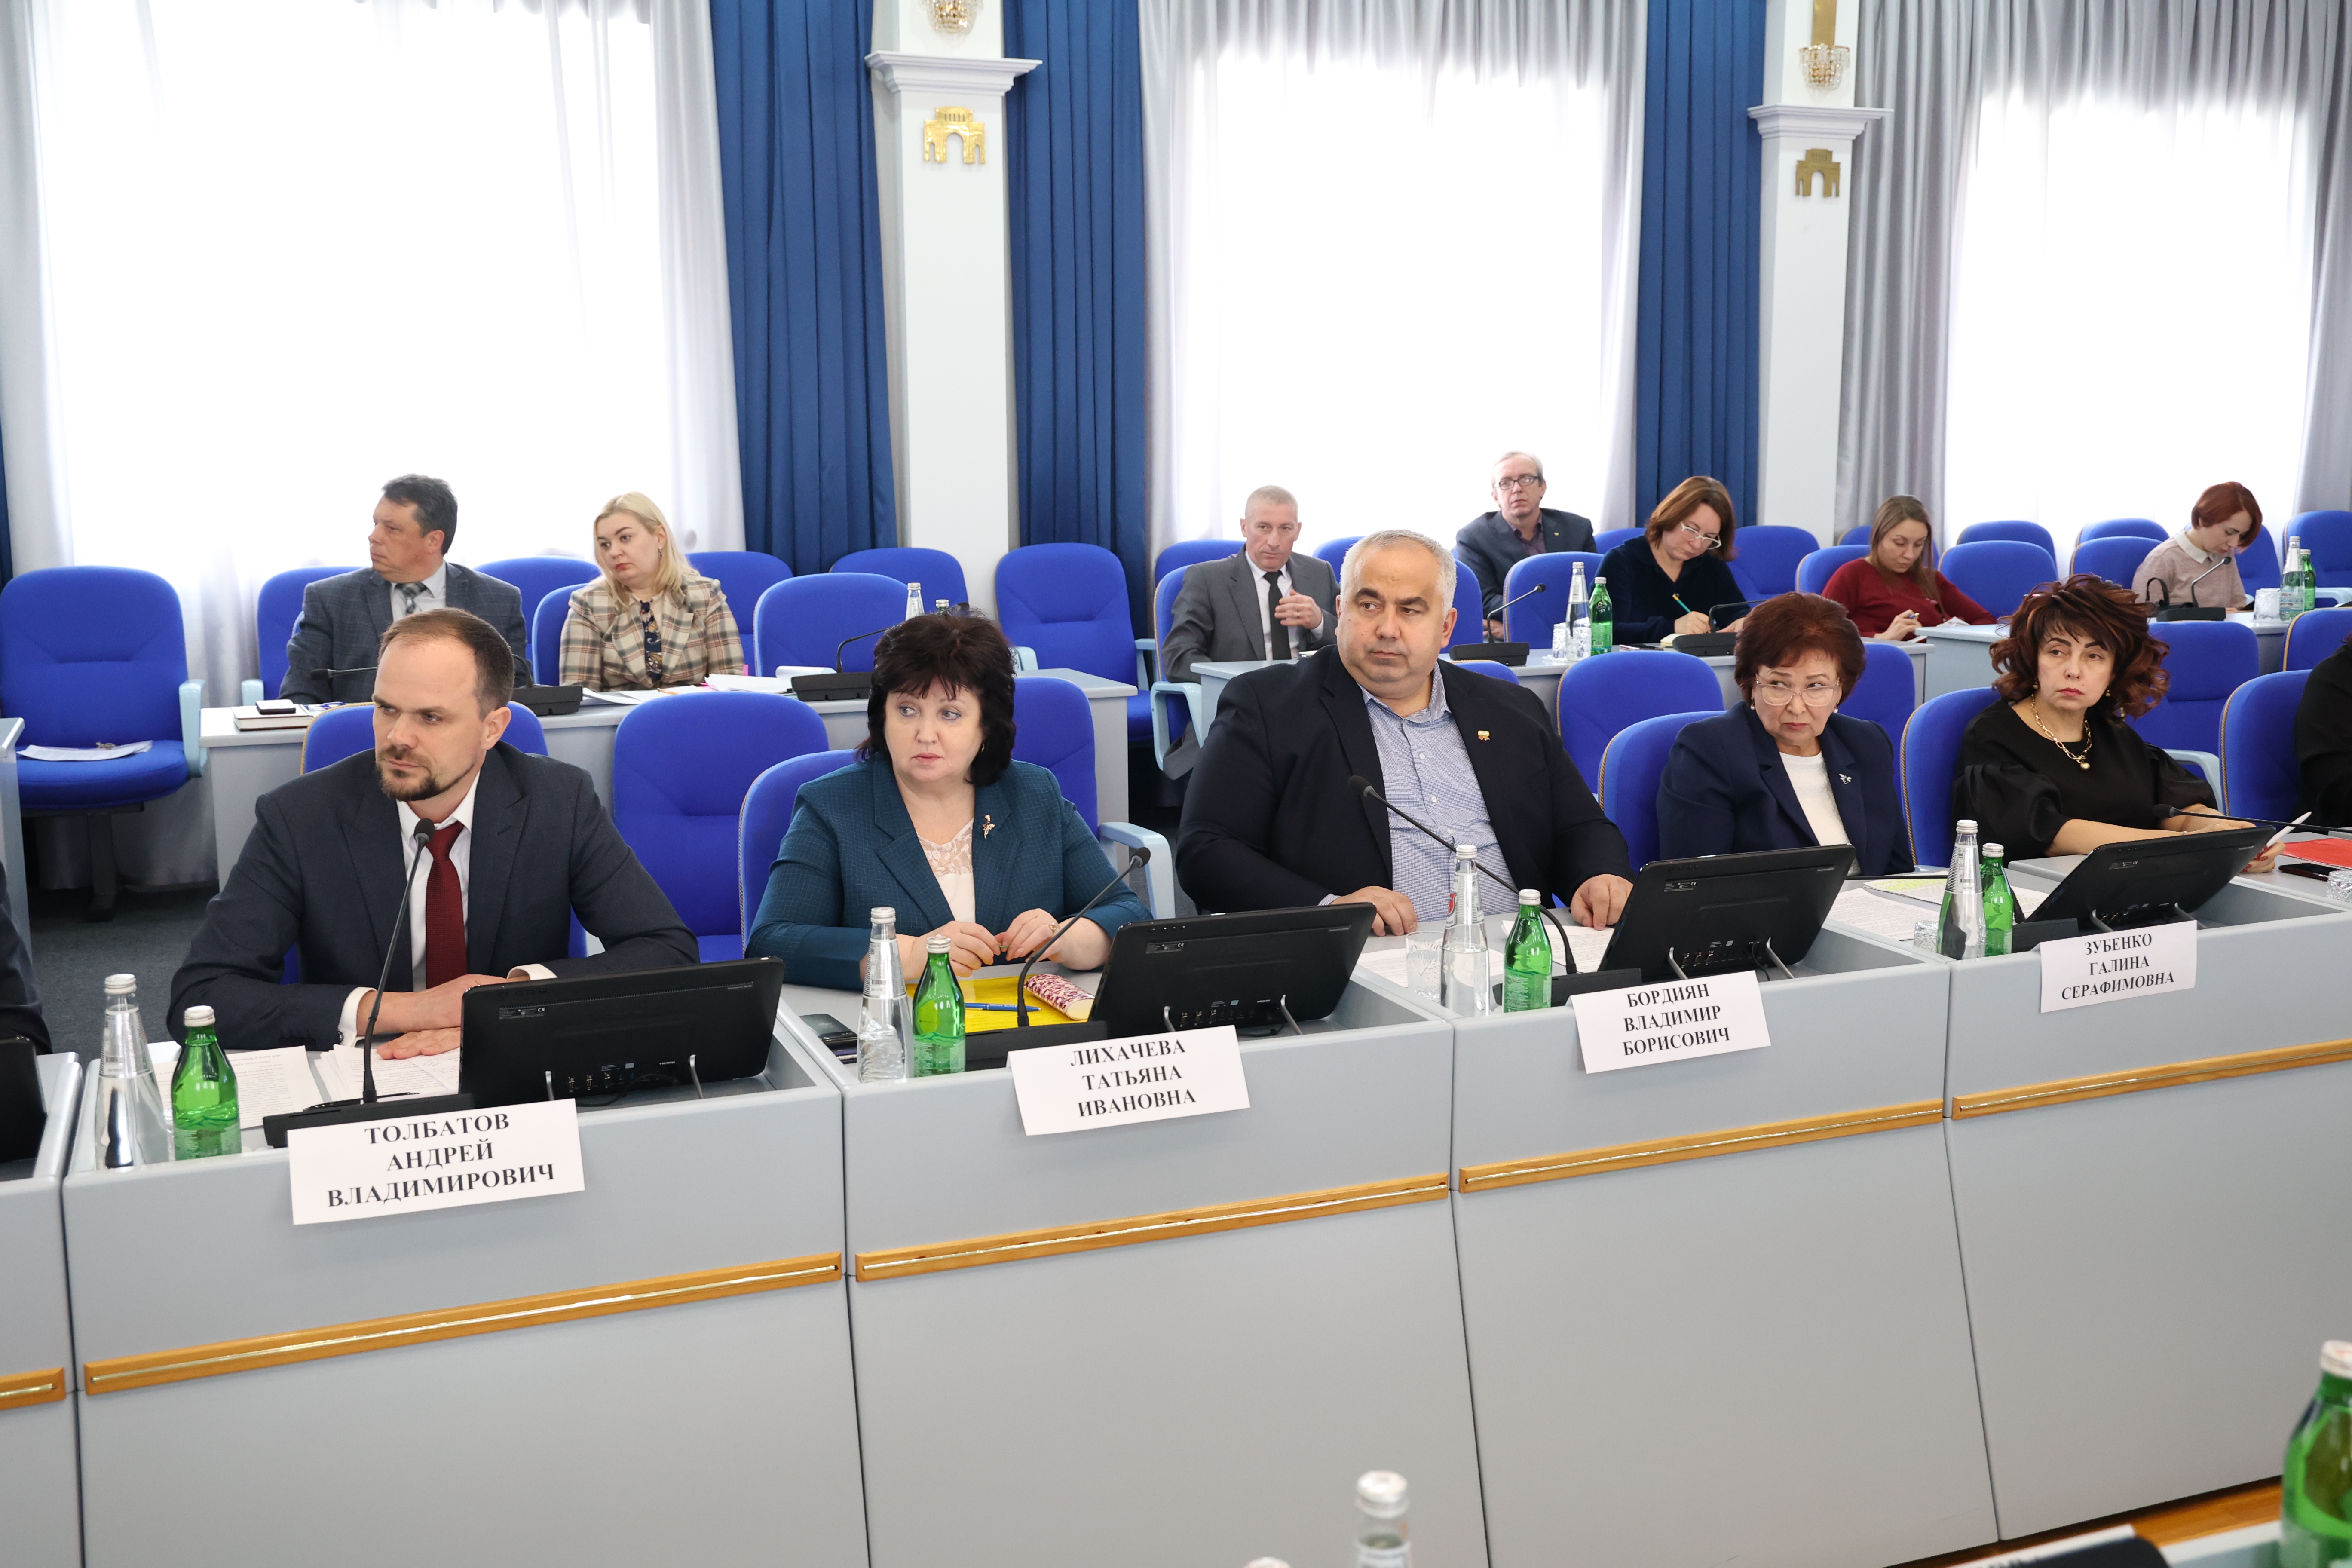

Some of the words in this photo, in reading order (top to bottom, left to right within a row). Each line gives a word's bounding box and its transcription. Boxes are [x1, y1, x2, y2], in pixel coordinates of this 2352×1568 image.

[2085, 933, 2152, 955] ЗУБЕНКО
[2089, 955, 2150, 976] ГАЛИНА
[1626, 983, 1710, 1008] БОРДИЯН
[2061, 971, 2174, 1000] СЕРАФИМОВНА
[1623, 1005, 1721, 1032] ВЛАДИМИР
[1071, 1039, 1186, 1066] ЛИХАЧЕВА
[1622, 1027, 1730, 1056] БОРИСОВИЧ
[1082, 1065, 1182, 1090] ТАТЬЯНА
[1078, 1089, 1197, 1117] ИВАНОВНА
[365, 1113, 509, 1144] ТОЛБАТОВ
[387, 1138, 495, 1171] АНДРЕЙ
[327, 1164, 556, 1207] ВЛАДИМИРОВИЧ
